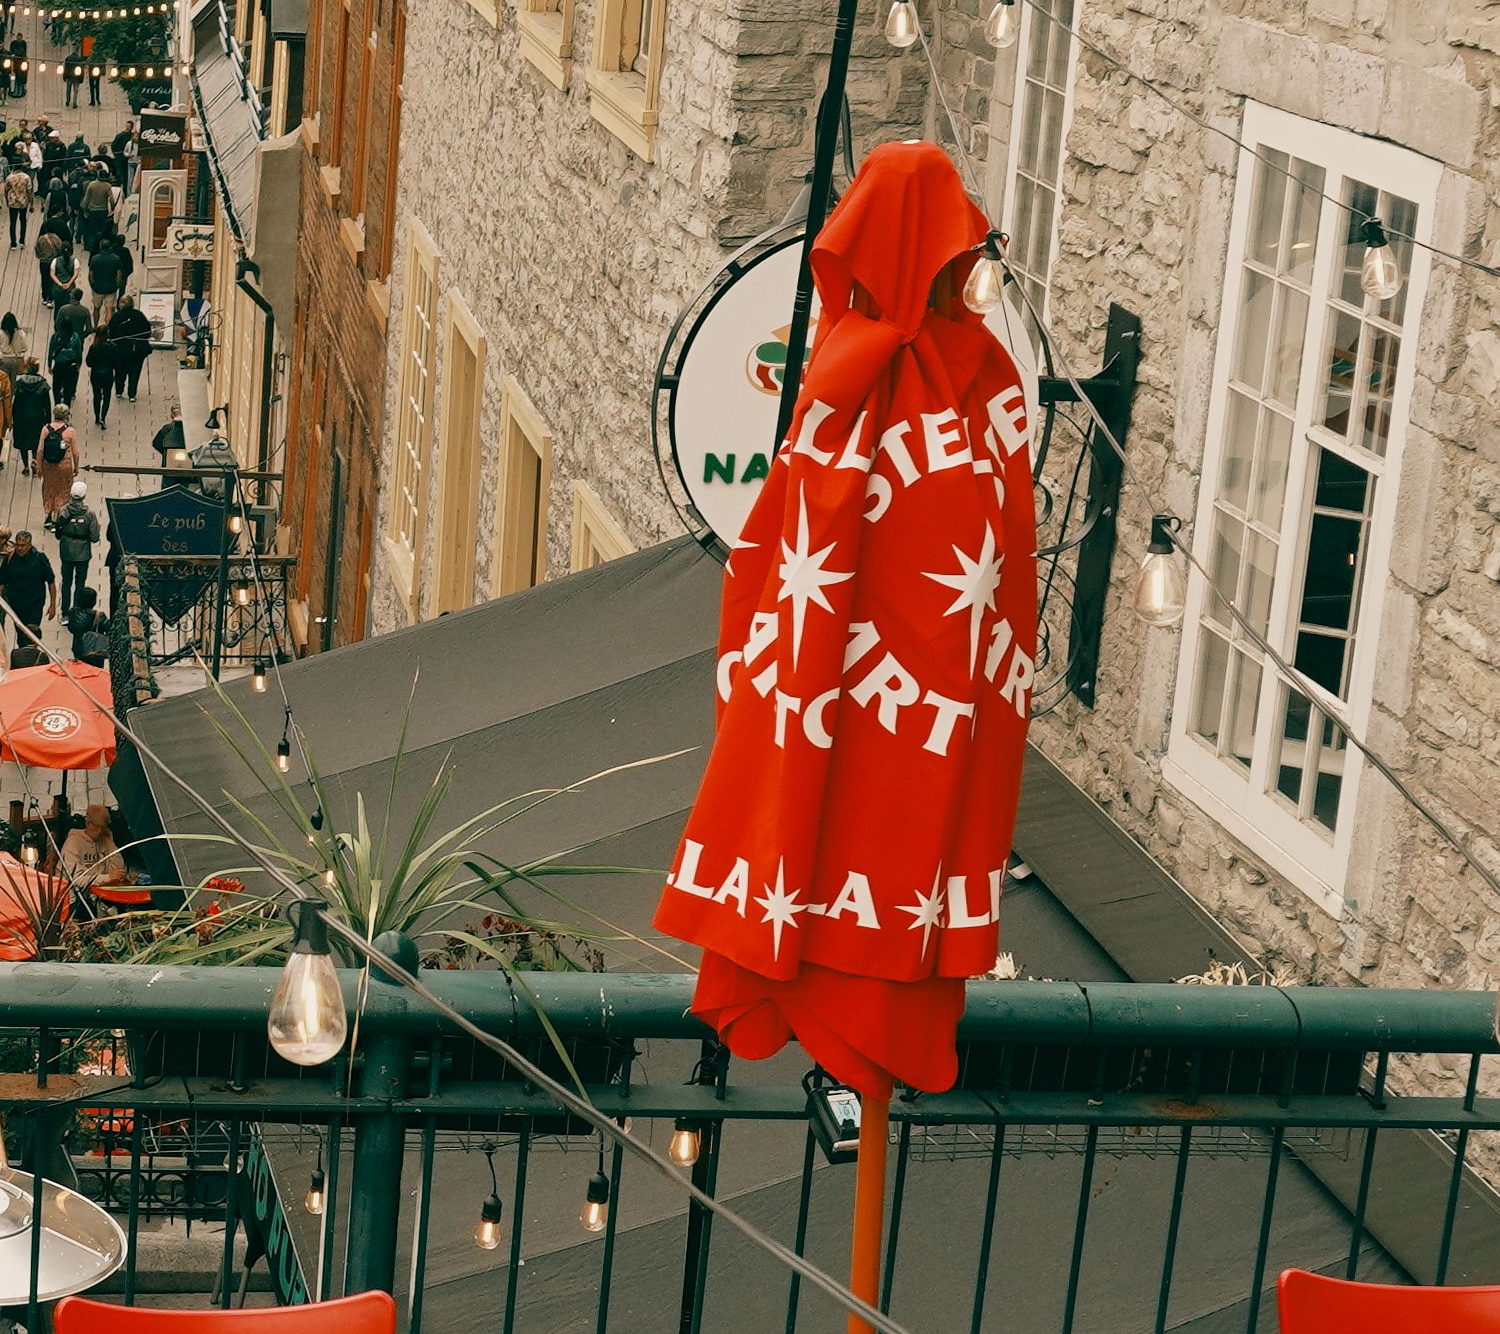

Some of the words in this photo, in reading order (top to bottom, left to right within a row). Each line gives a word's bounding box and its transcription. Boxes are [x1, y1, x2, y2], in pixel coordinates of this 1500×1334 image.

[148, 513, 169, 528] Le
[174, 513, 206, 530] pub
[162, 535, 190, 552] des
